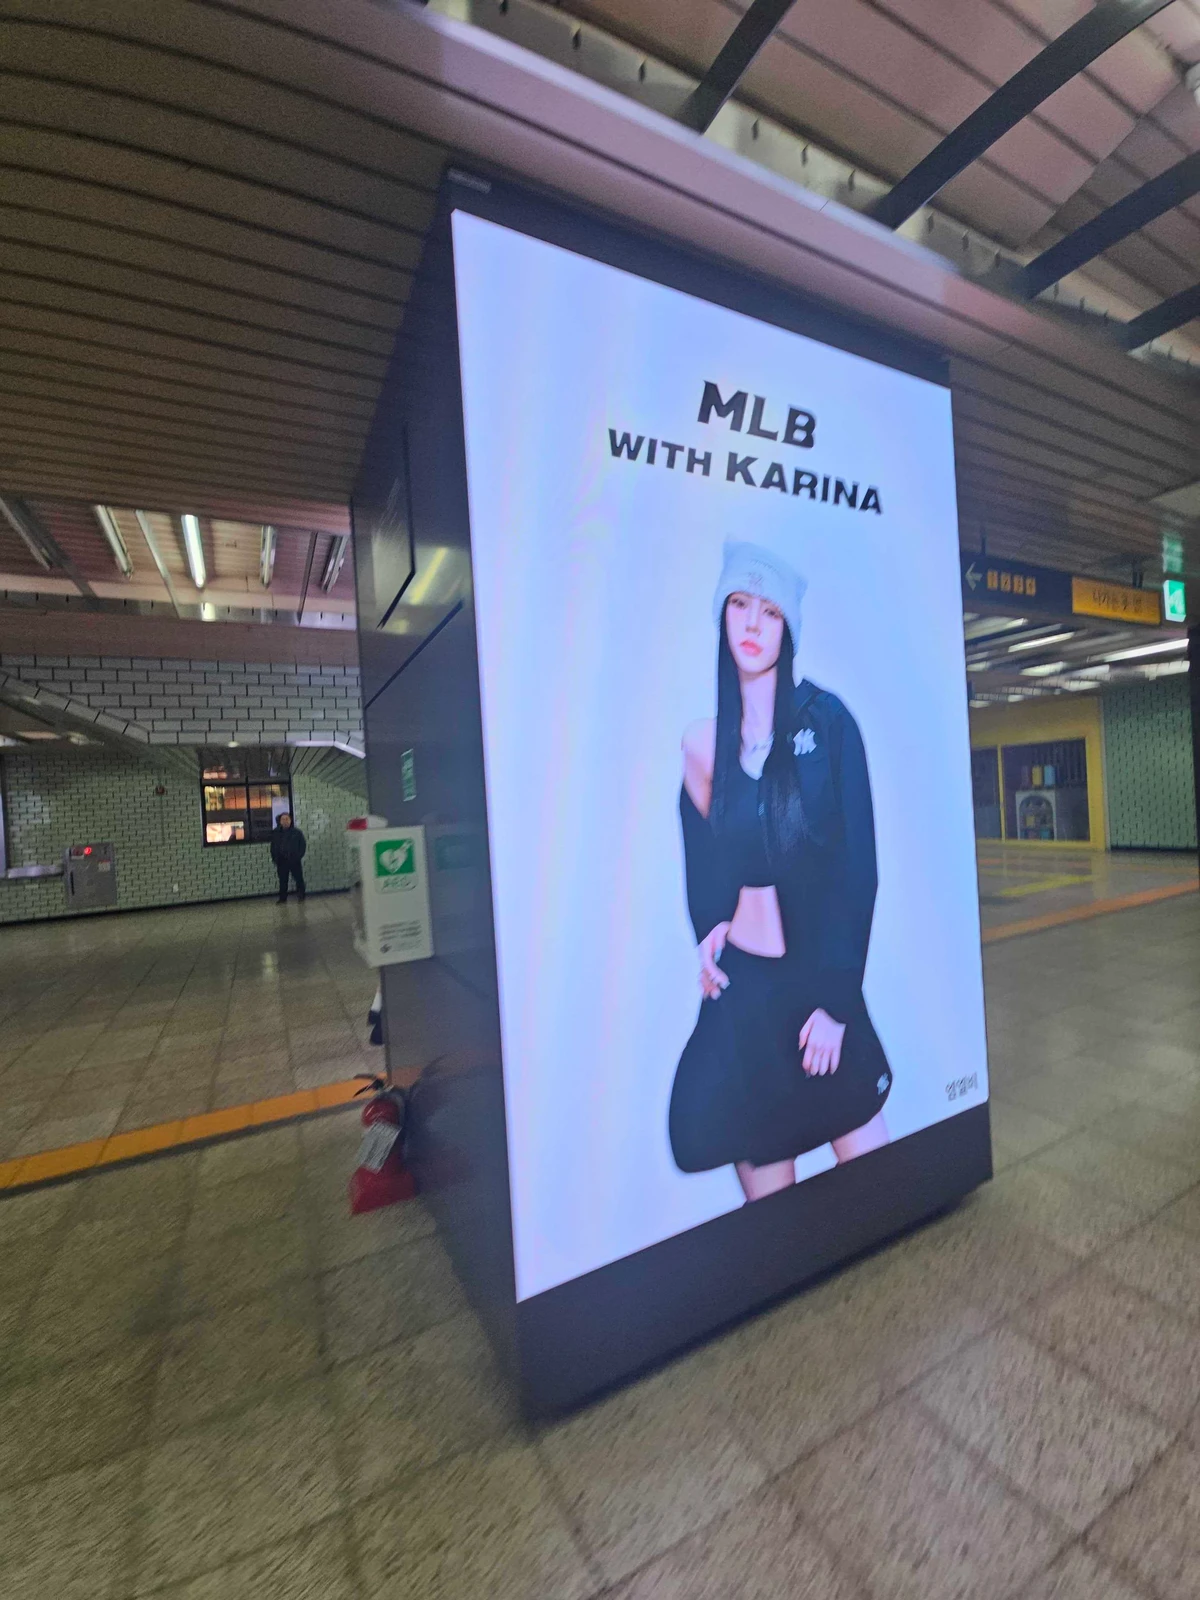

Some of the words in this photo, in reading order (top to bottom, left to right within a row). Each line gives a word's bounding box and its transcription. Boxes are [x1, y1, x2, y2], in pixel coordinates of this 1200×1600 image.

[697, 380, 816, 449] MLB
[608, 428, 712, 477] WITH
[726, 451, 884, 515] KARINA
